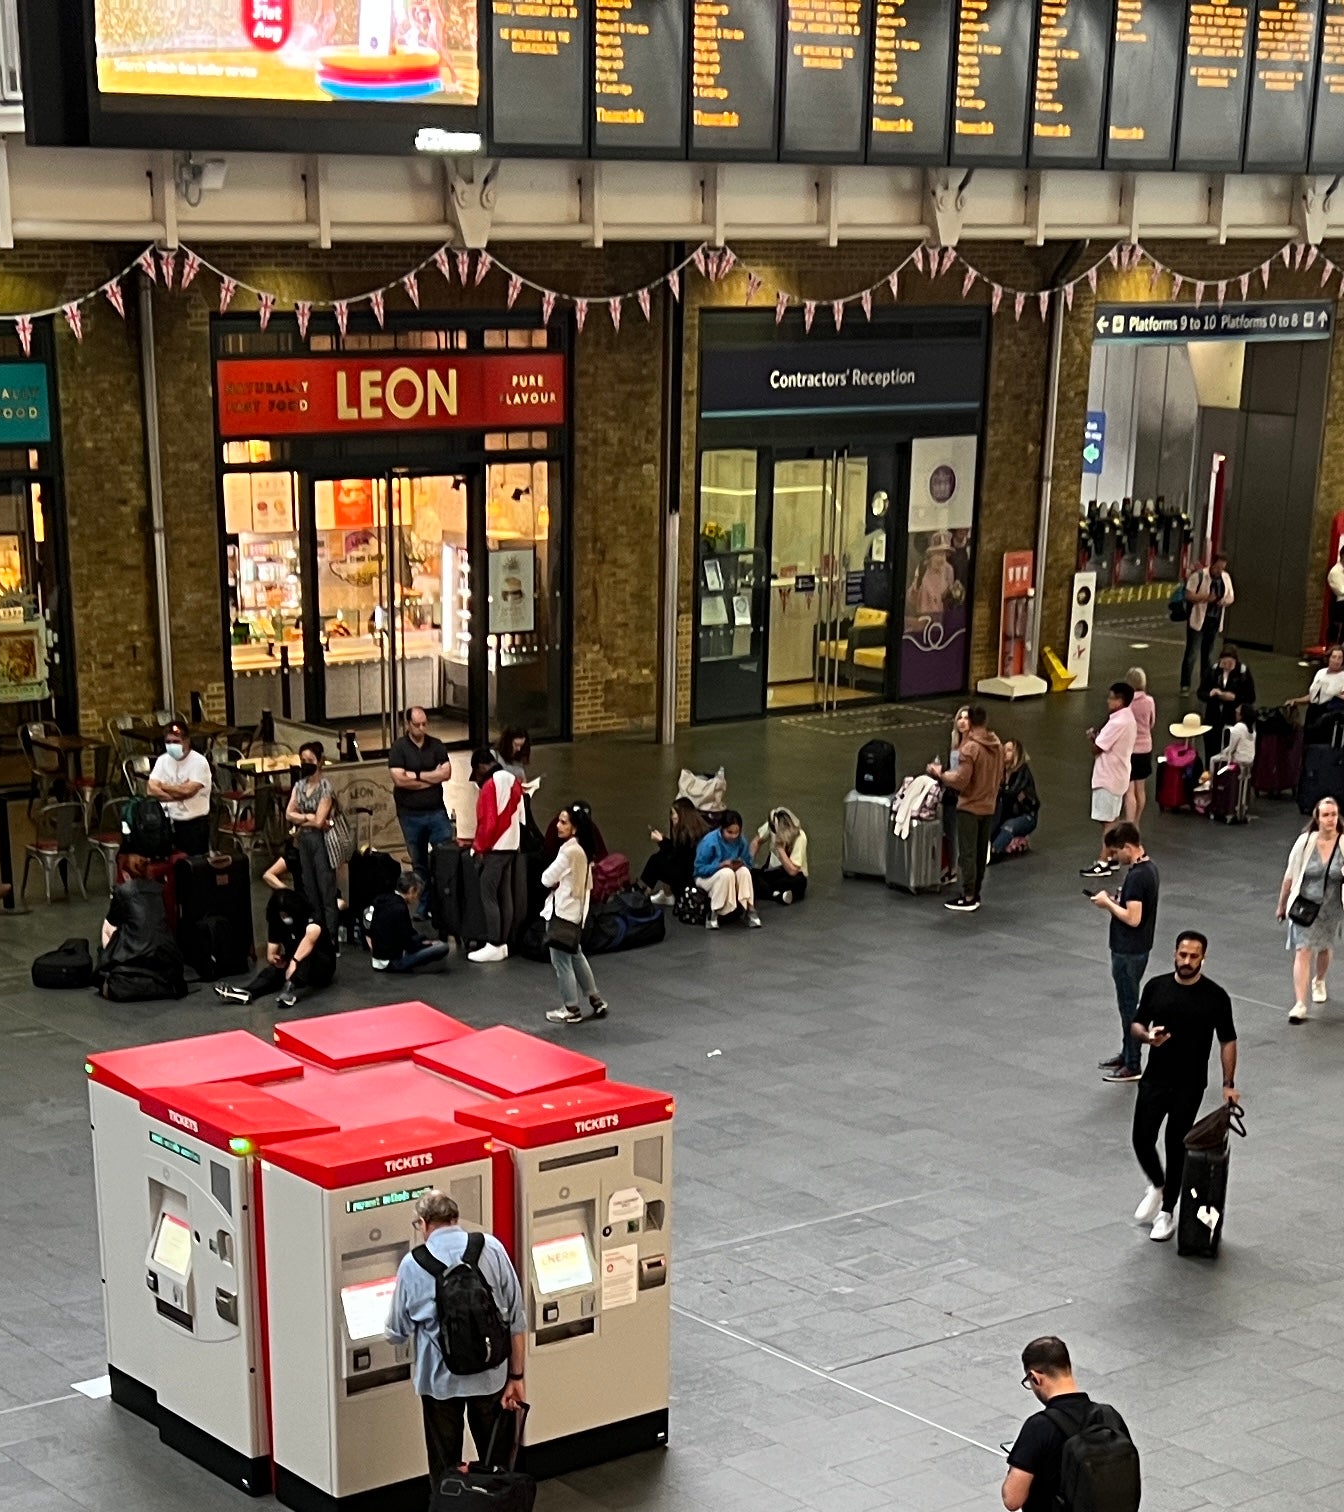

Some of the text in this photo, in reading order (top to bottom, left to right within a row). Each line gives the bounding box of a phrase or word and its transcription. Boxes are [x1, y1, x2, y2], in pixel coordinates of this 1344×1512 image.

[1128, 314, 1216, 332] Platforms 9 to 10
[1221, 312, 1298, 330] Platforms 0 to 8
[512, 374, 545, 388] PURE
[769, 367, 916, 389] Contractors' Reception
[336, 367, 458, 420] LEON
[168, 1109, 198, 1133] TICKETS
[574, 1114, 619, 1133] TICKETS
[384, 1153, 434, 1173] TICKETS
